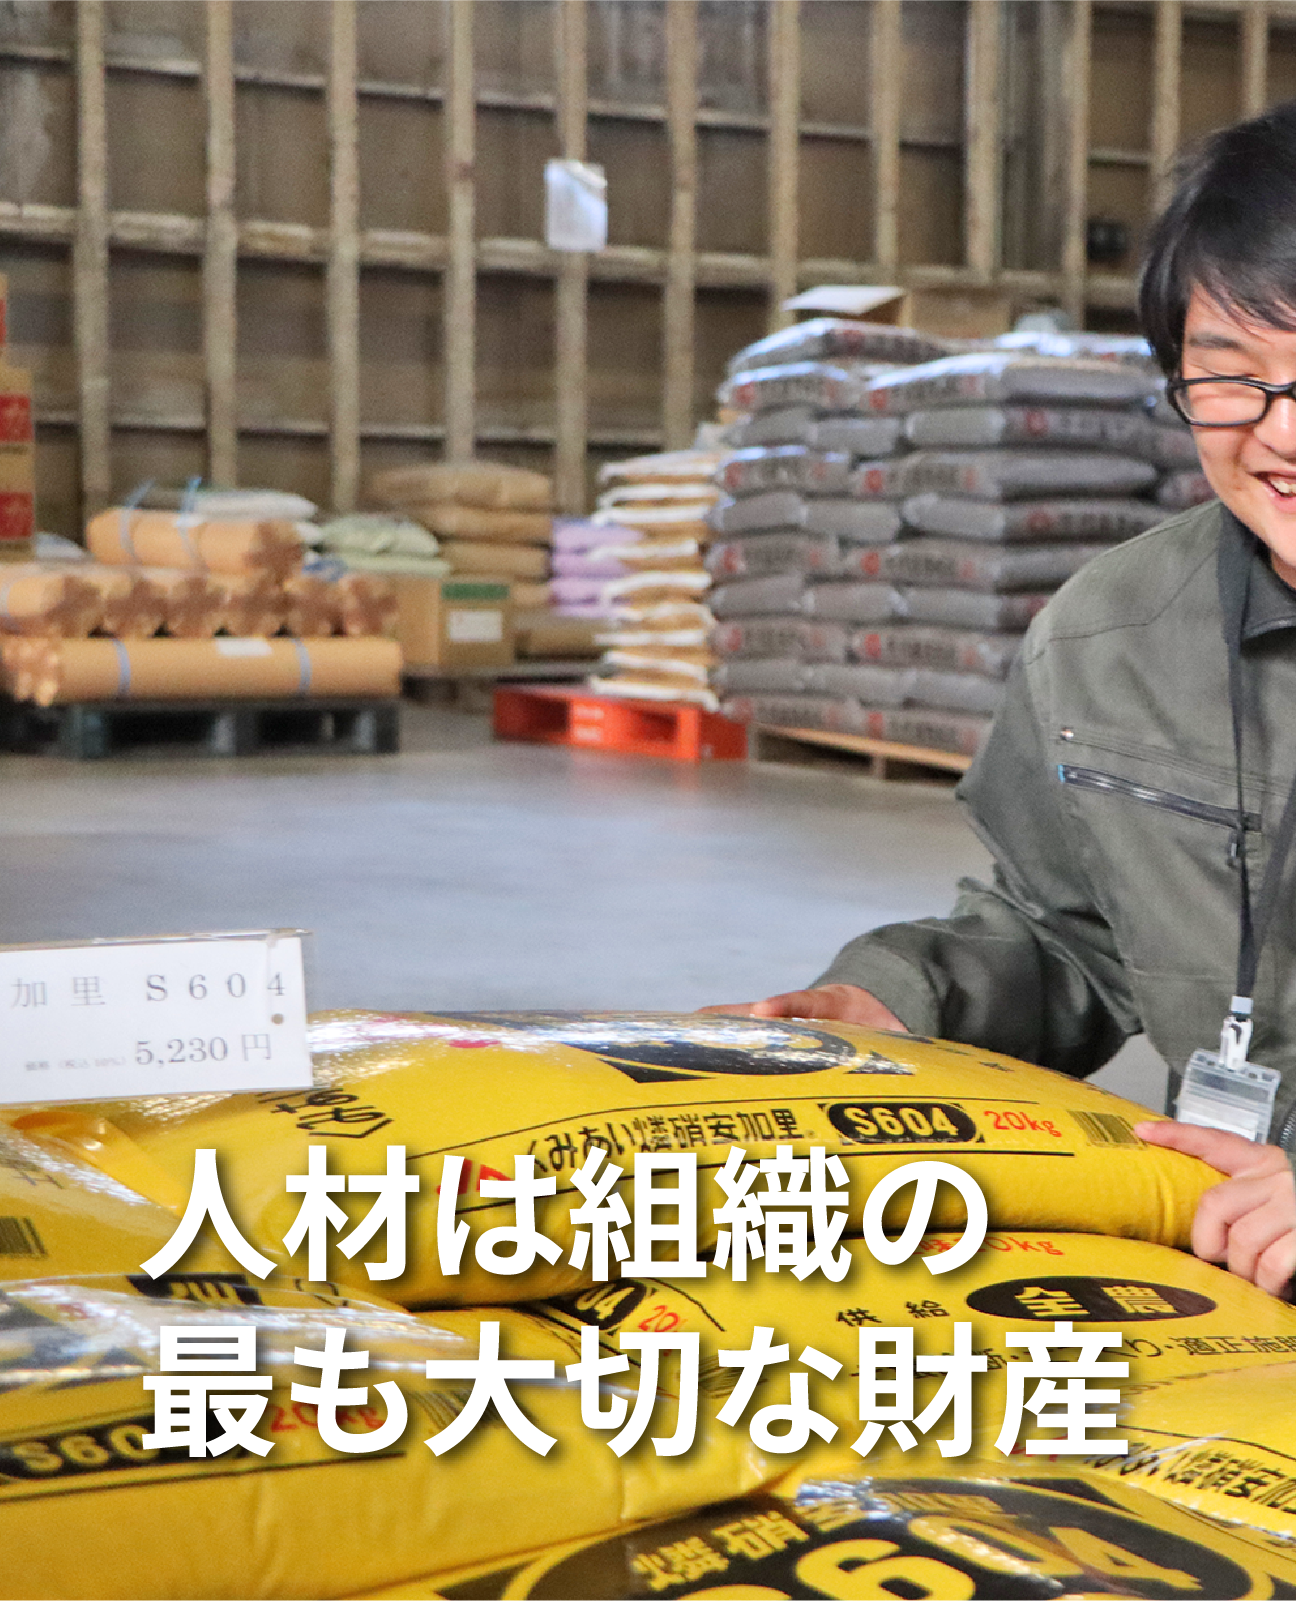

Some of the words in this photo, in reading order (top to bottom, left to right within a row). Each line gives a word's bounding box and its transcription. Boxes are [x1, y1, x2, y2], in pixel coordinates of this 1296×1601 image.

[11, 976, 105, 1008] 加里
[146, 972, 285, 1001] S604
[843, 1107, 960, 1137] S604
[984, 1110, 1063, 1138] 20kg
[675, 1515, 1202, 1601] 604
